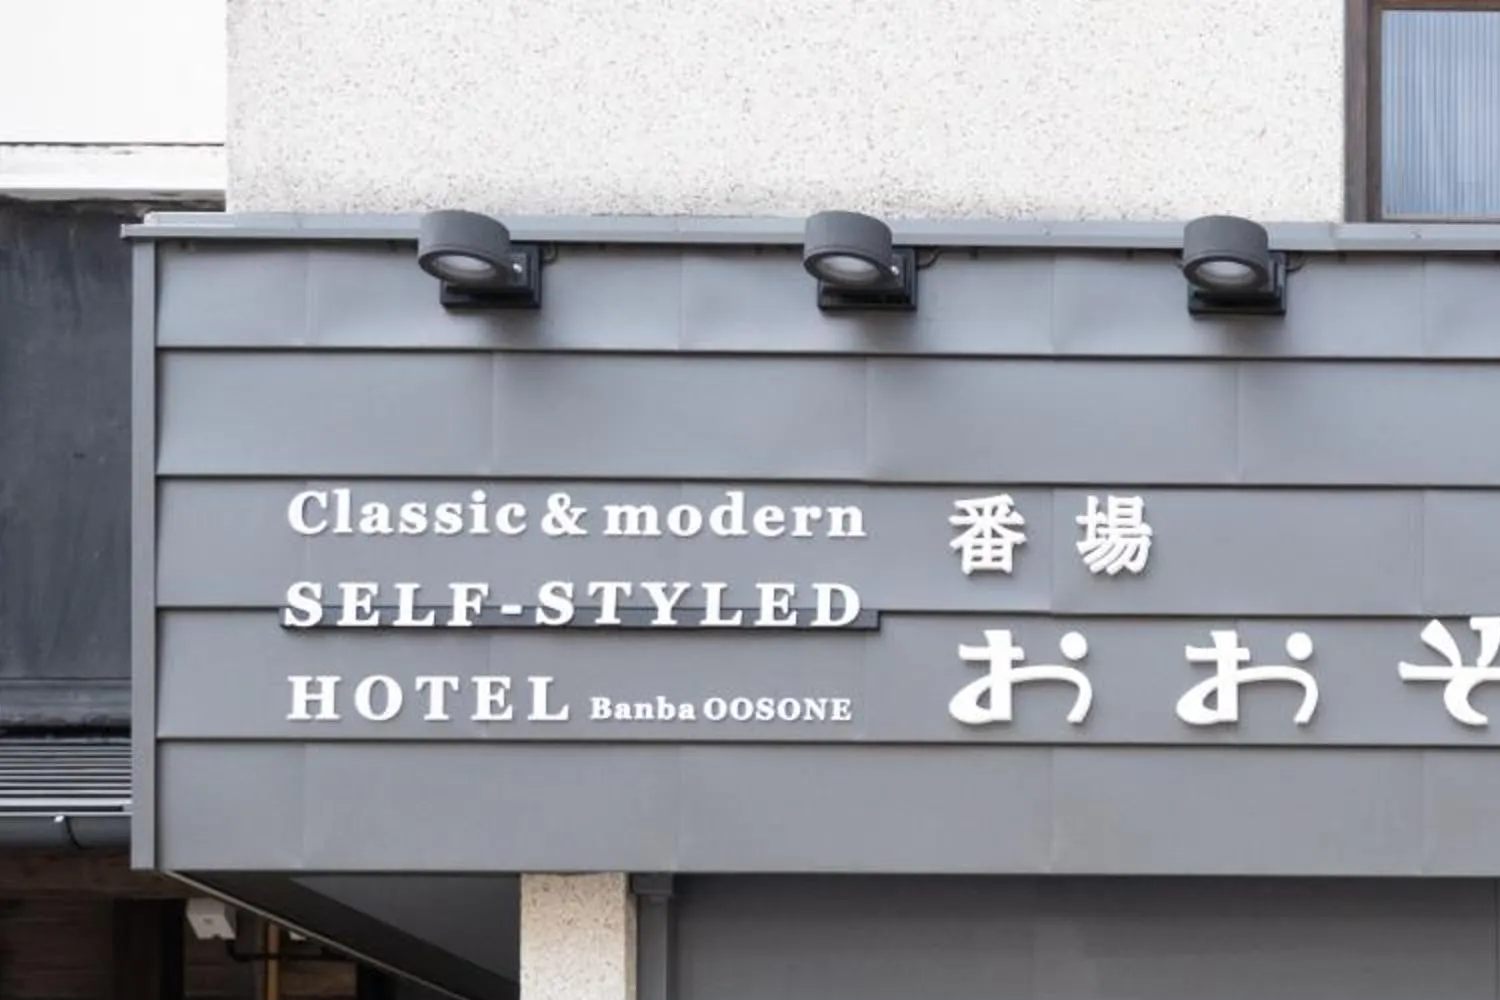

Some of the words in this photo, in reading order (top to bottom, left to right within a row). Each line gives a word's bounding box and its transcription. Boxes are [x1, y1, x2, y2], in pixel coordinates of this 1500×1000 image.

[287, 489, 527, 536] Classic
[540, 493, 588, 536] &
[602, 491, 867, 538] modern
[948, 494, 1154, 577] 番場
[282, 581, 861, 627] SELF-STYLED
[286, 675, 569, 722] HOTEL
[590, 695, 696, 722] Banba
[703, 698, 852, 722] OOSONE
